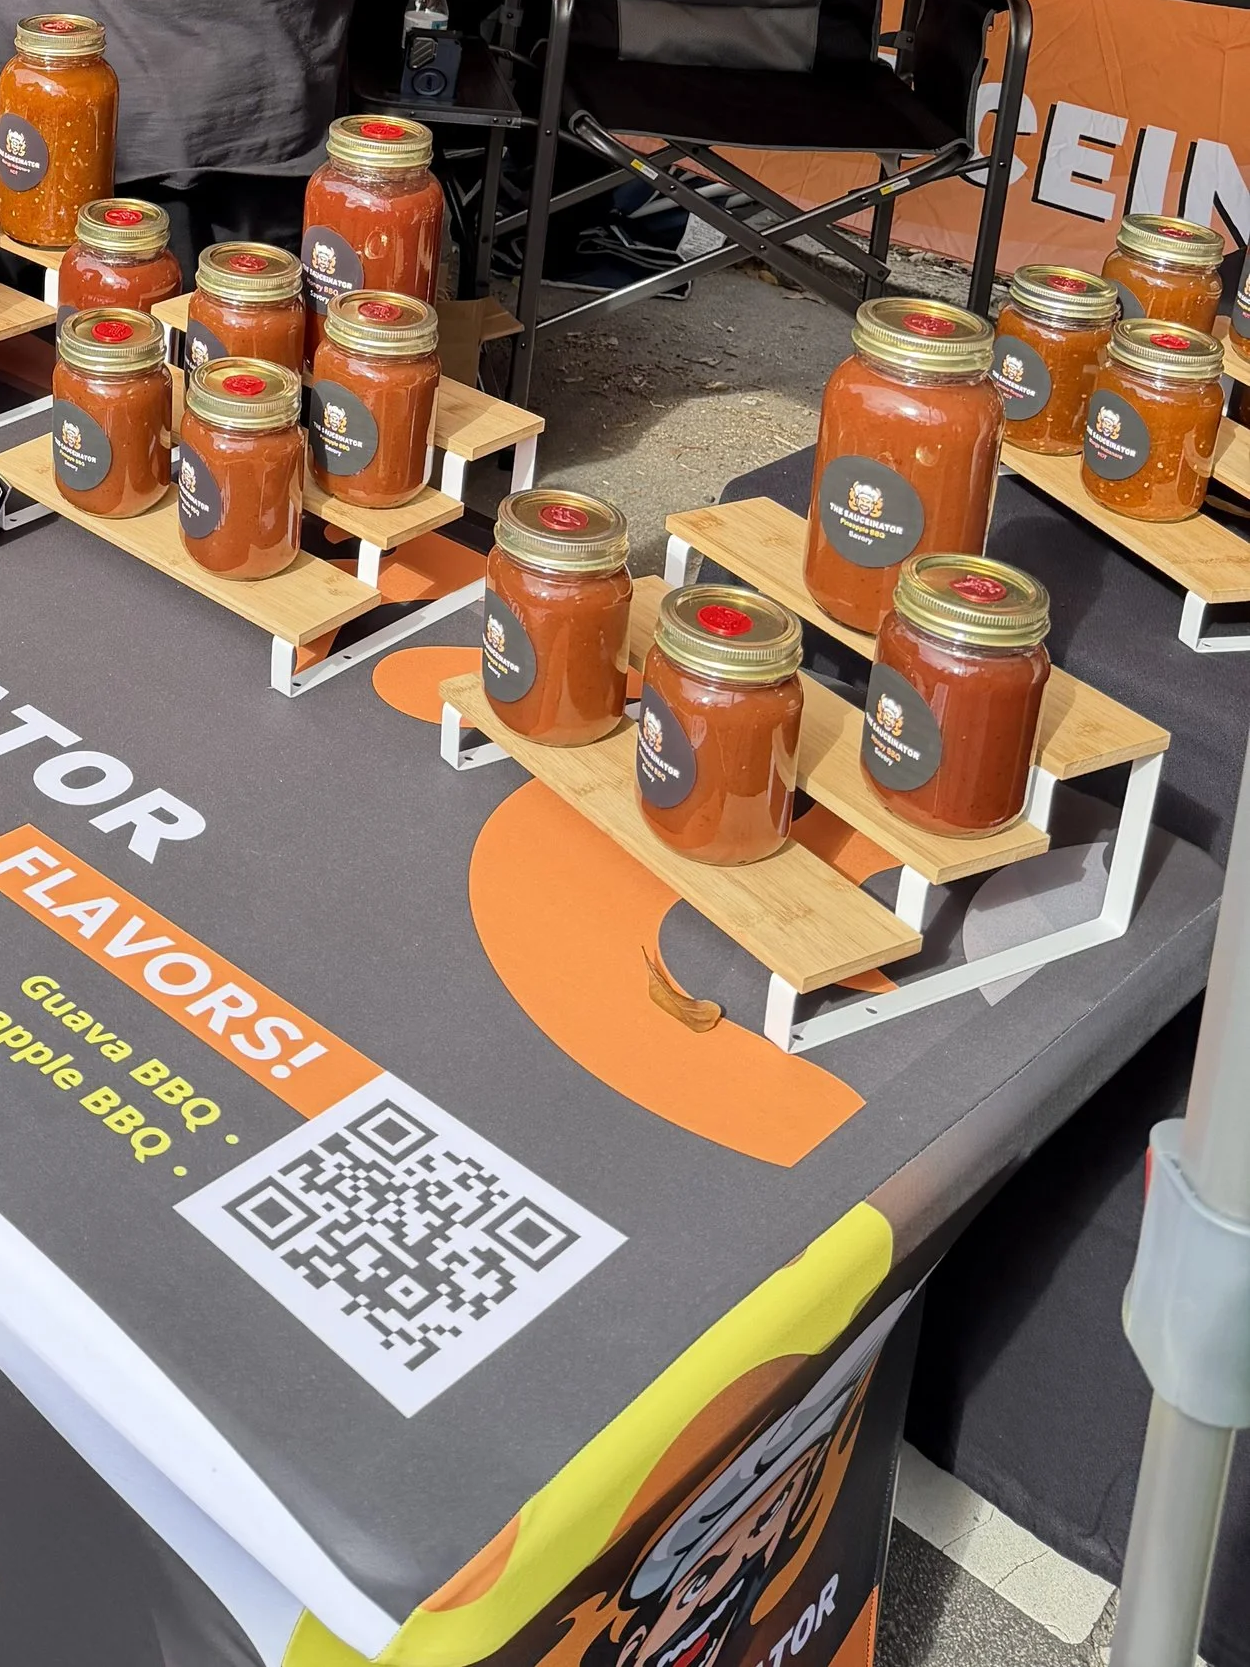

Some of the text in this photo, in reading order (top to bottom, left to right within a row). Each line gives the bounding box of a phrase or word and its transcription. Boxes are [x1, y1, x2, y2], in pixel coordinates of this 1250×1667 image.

[829, 501, 904, 535] THE SAUCEINATOR
[848, 530, 873, 546] Savory
[872, 722, 922, 761] SAUCEINATOR
[20, 974, 222, 1130] Guava BBQ
[79, 1090, 172, 1164] BBQ
